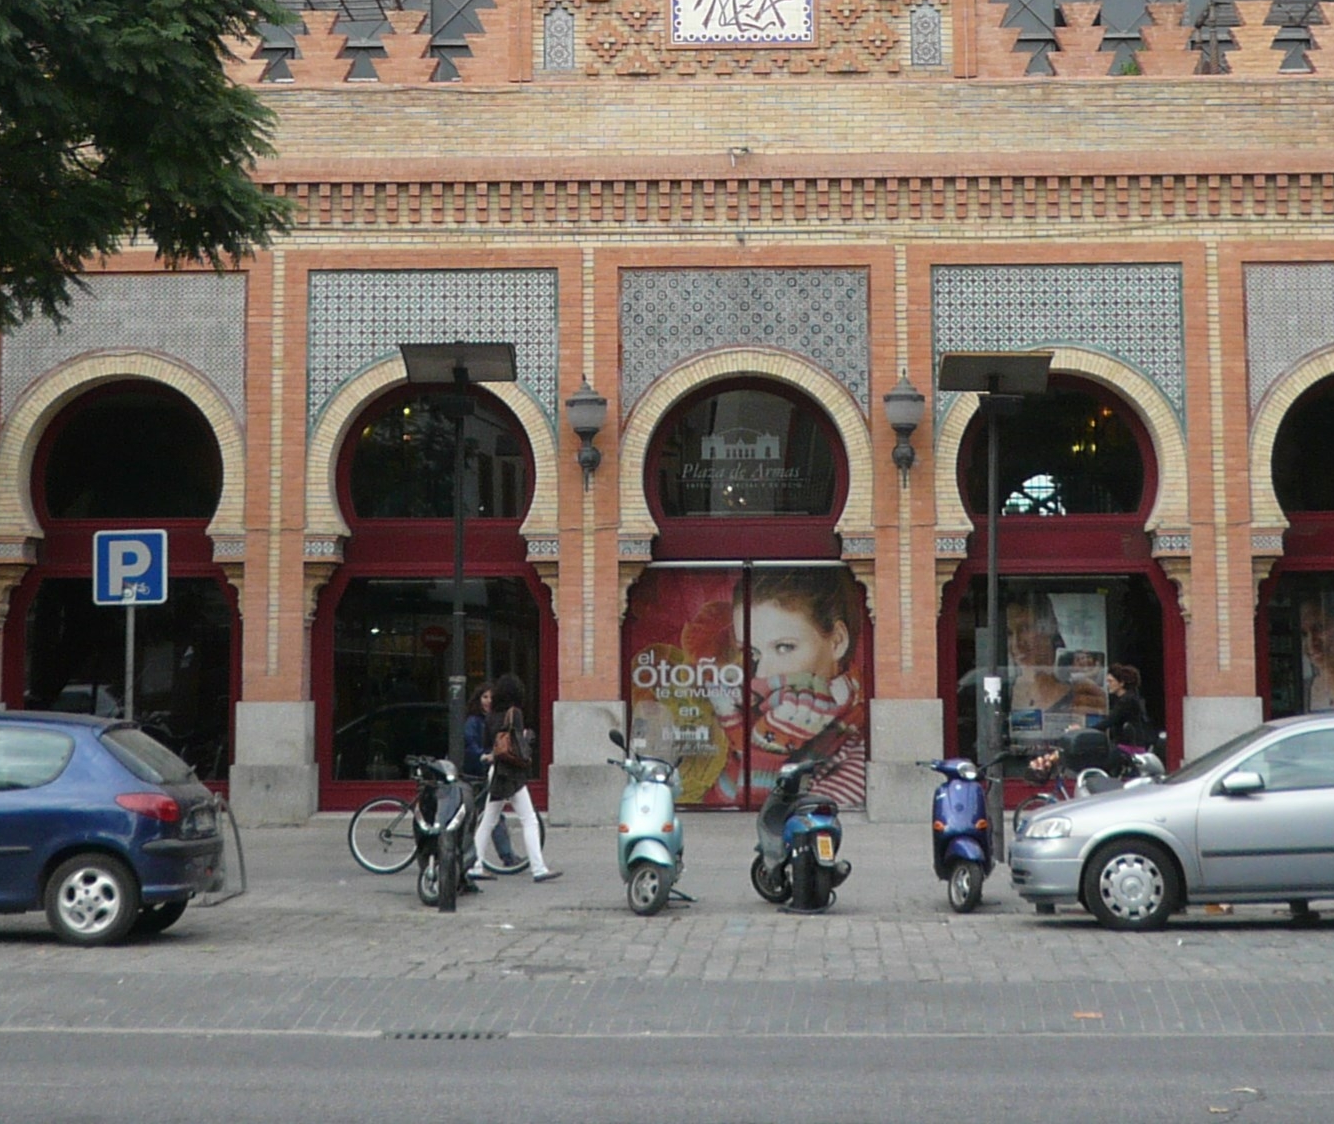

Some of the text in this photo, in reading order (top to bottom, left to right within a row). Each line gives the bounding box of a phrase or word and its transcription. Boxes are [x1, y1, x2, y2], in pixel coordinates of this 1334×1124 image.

[682, 461, 800, 479] Plaza de Armas
[109, 540, 152, 596] P
[638, 649, 655, 665] el
[632, 656, 745, 688] otoño
[656, 686, 742, 699] te envuelve
[679, 705, 700, 717] en
